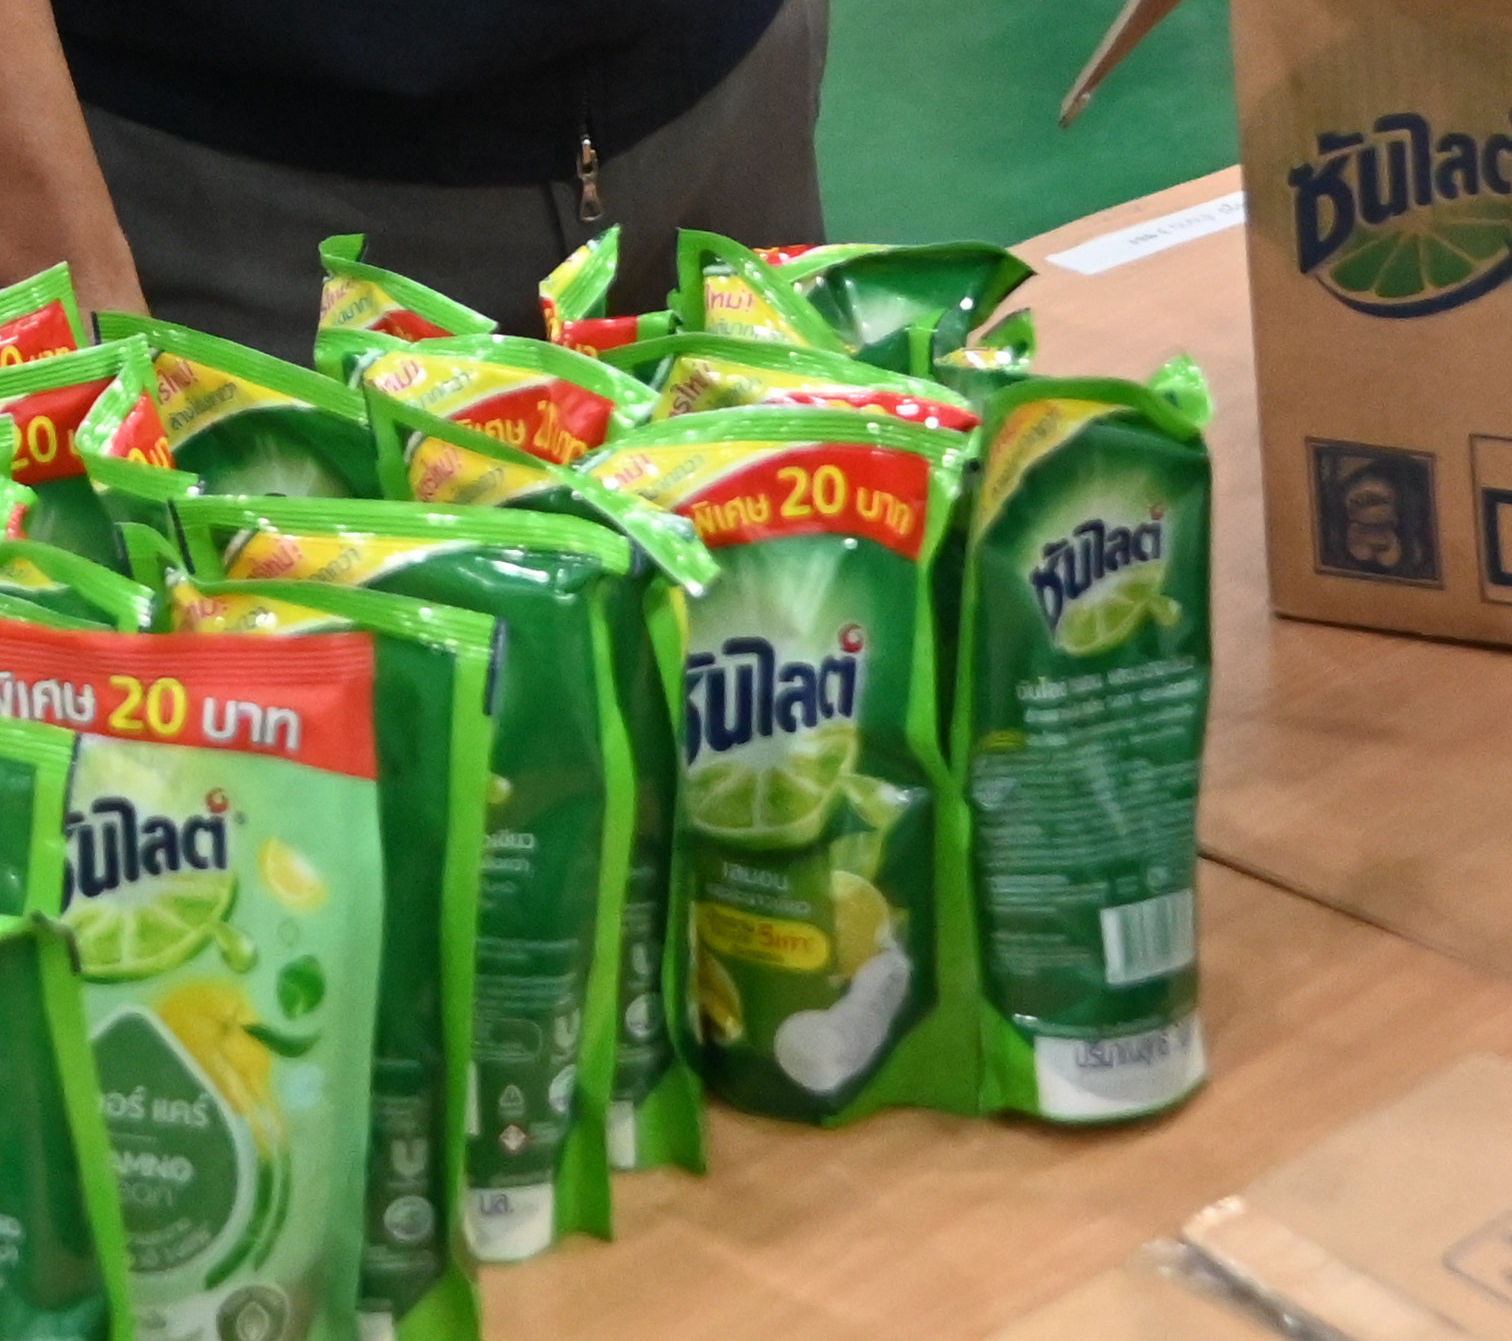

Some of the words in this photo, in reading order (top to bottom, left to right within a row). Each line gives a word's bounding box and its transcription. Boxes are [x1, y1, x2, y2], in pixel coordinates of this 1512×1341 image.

[776, 464, 847, 518] 20
[855, 486, 916, 536] บาท
[108, 674, 190, 737] 20
[200, 695, 303, 752] บาท
[63, 786, 230, 915] ันไลต์
